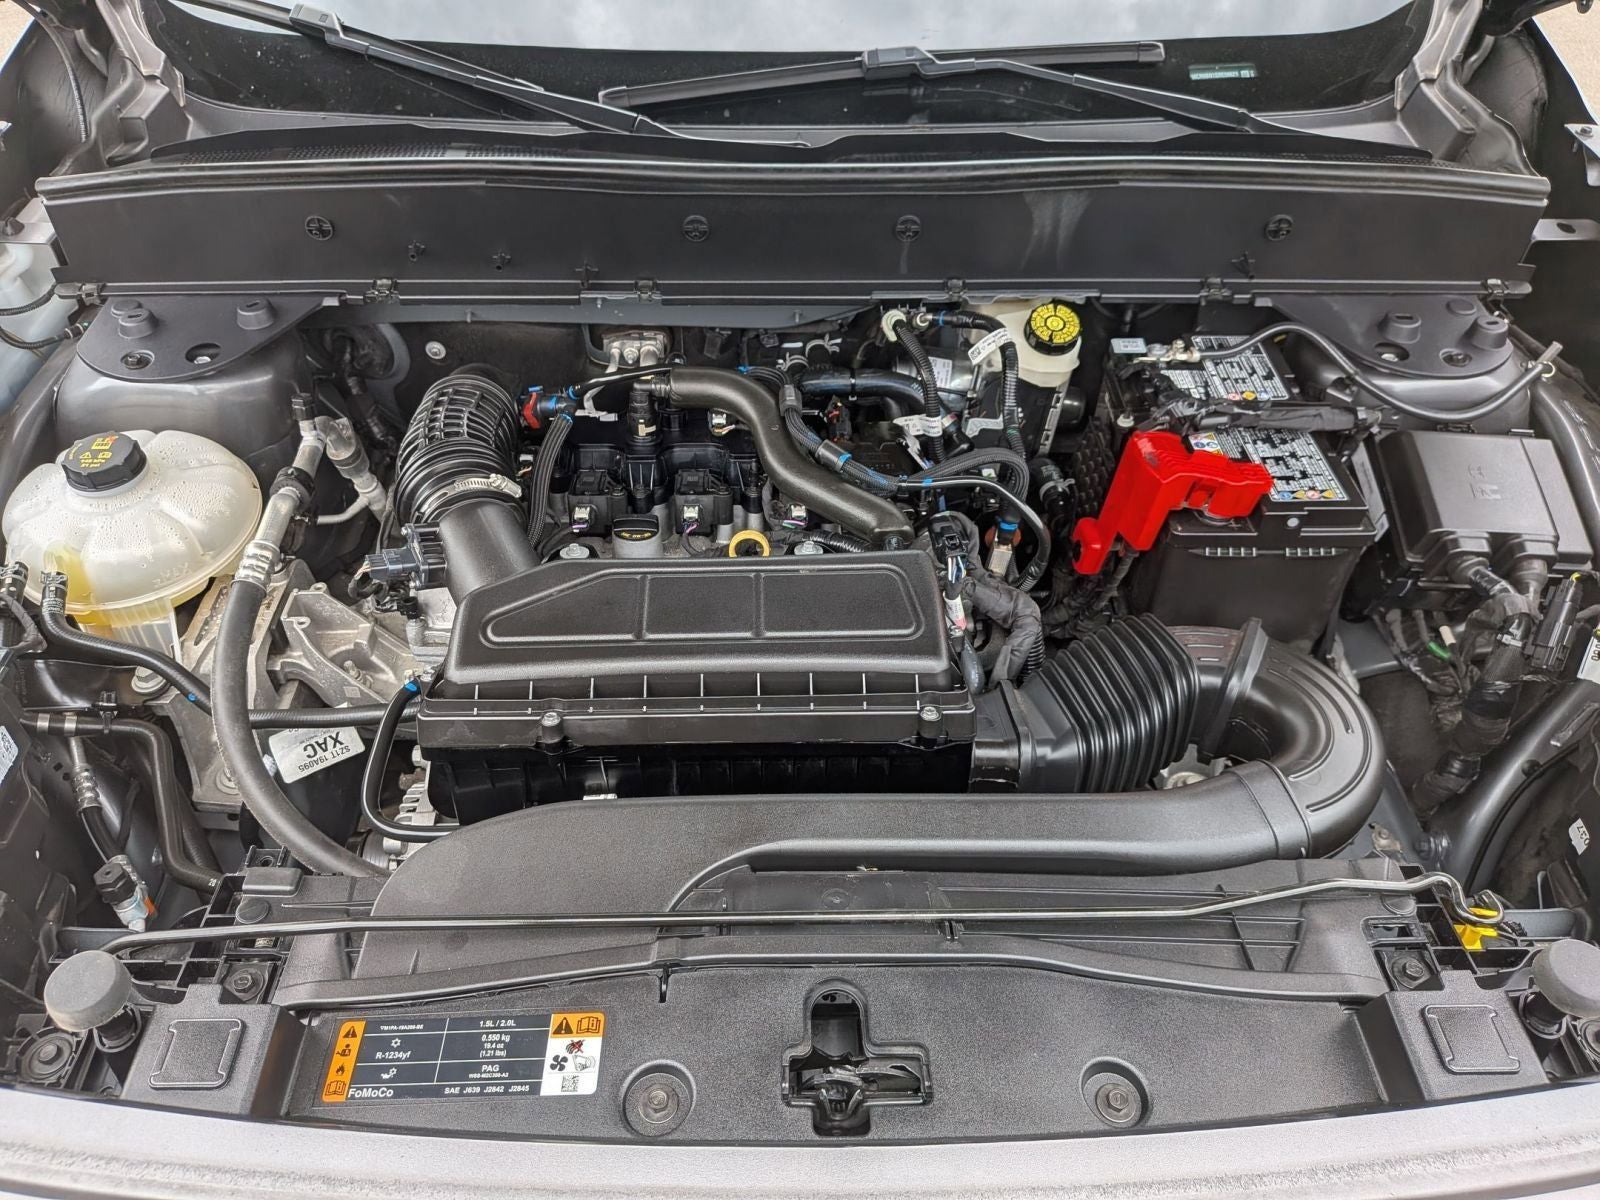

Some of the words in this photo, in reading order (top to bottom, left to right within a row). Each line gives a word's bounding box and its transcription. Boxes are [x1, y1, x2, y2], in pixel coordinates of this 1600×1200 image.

[303, 731, 345, 759] XAC
[298, 755, 329, 773] 19A095
[479, 1020, 495, 1028] 1.5L
[500, 1019, 516, 1027] 2.0L
[481, 1034, 500, 1042] 0.550
[501, 1034, 511, 1042] kg
[375, 1051, 411, 1060] R-1234yf
[479, 1050, 493, 1058] (1.21
[347, 1086, 394, 1098] FoMoCo
[463, 1086, 480, 1094] J639
